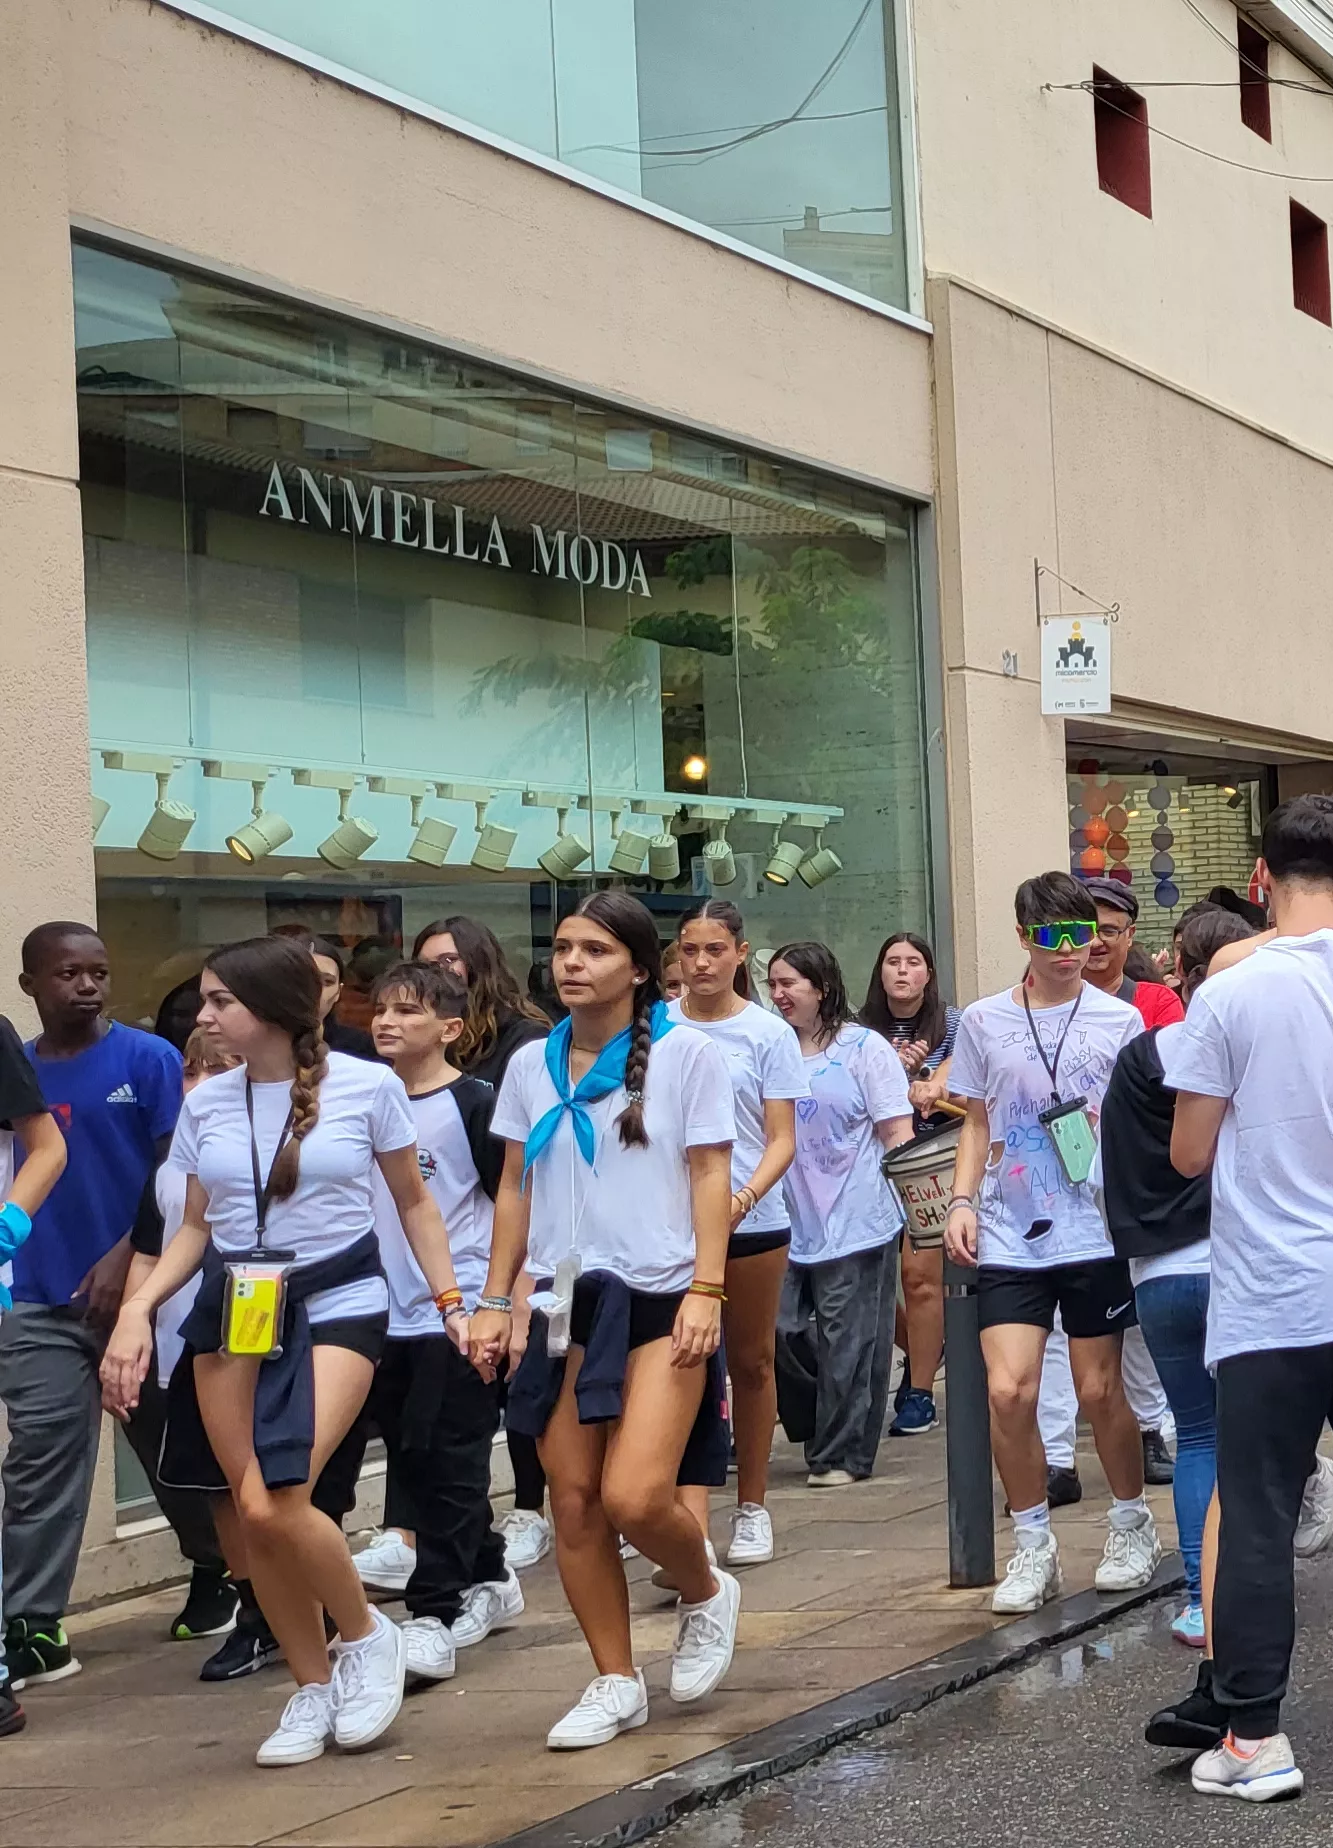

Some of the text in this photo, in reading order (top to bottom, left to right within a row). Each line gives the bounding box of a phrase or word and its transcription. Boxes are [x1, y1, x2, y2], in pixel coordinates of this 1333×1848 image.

[258, 461, 652, 598] ANMELLA MODA
[1002, 649, 1018, 677] 21
